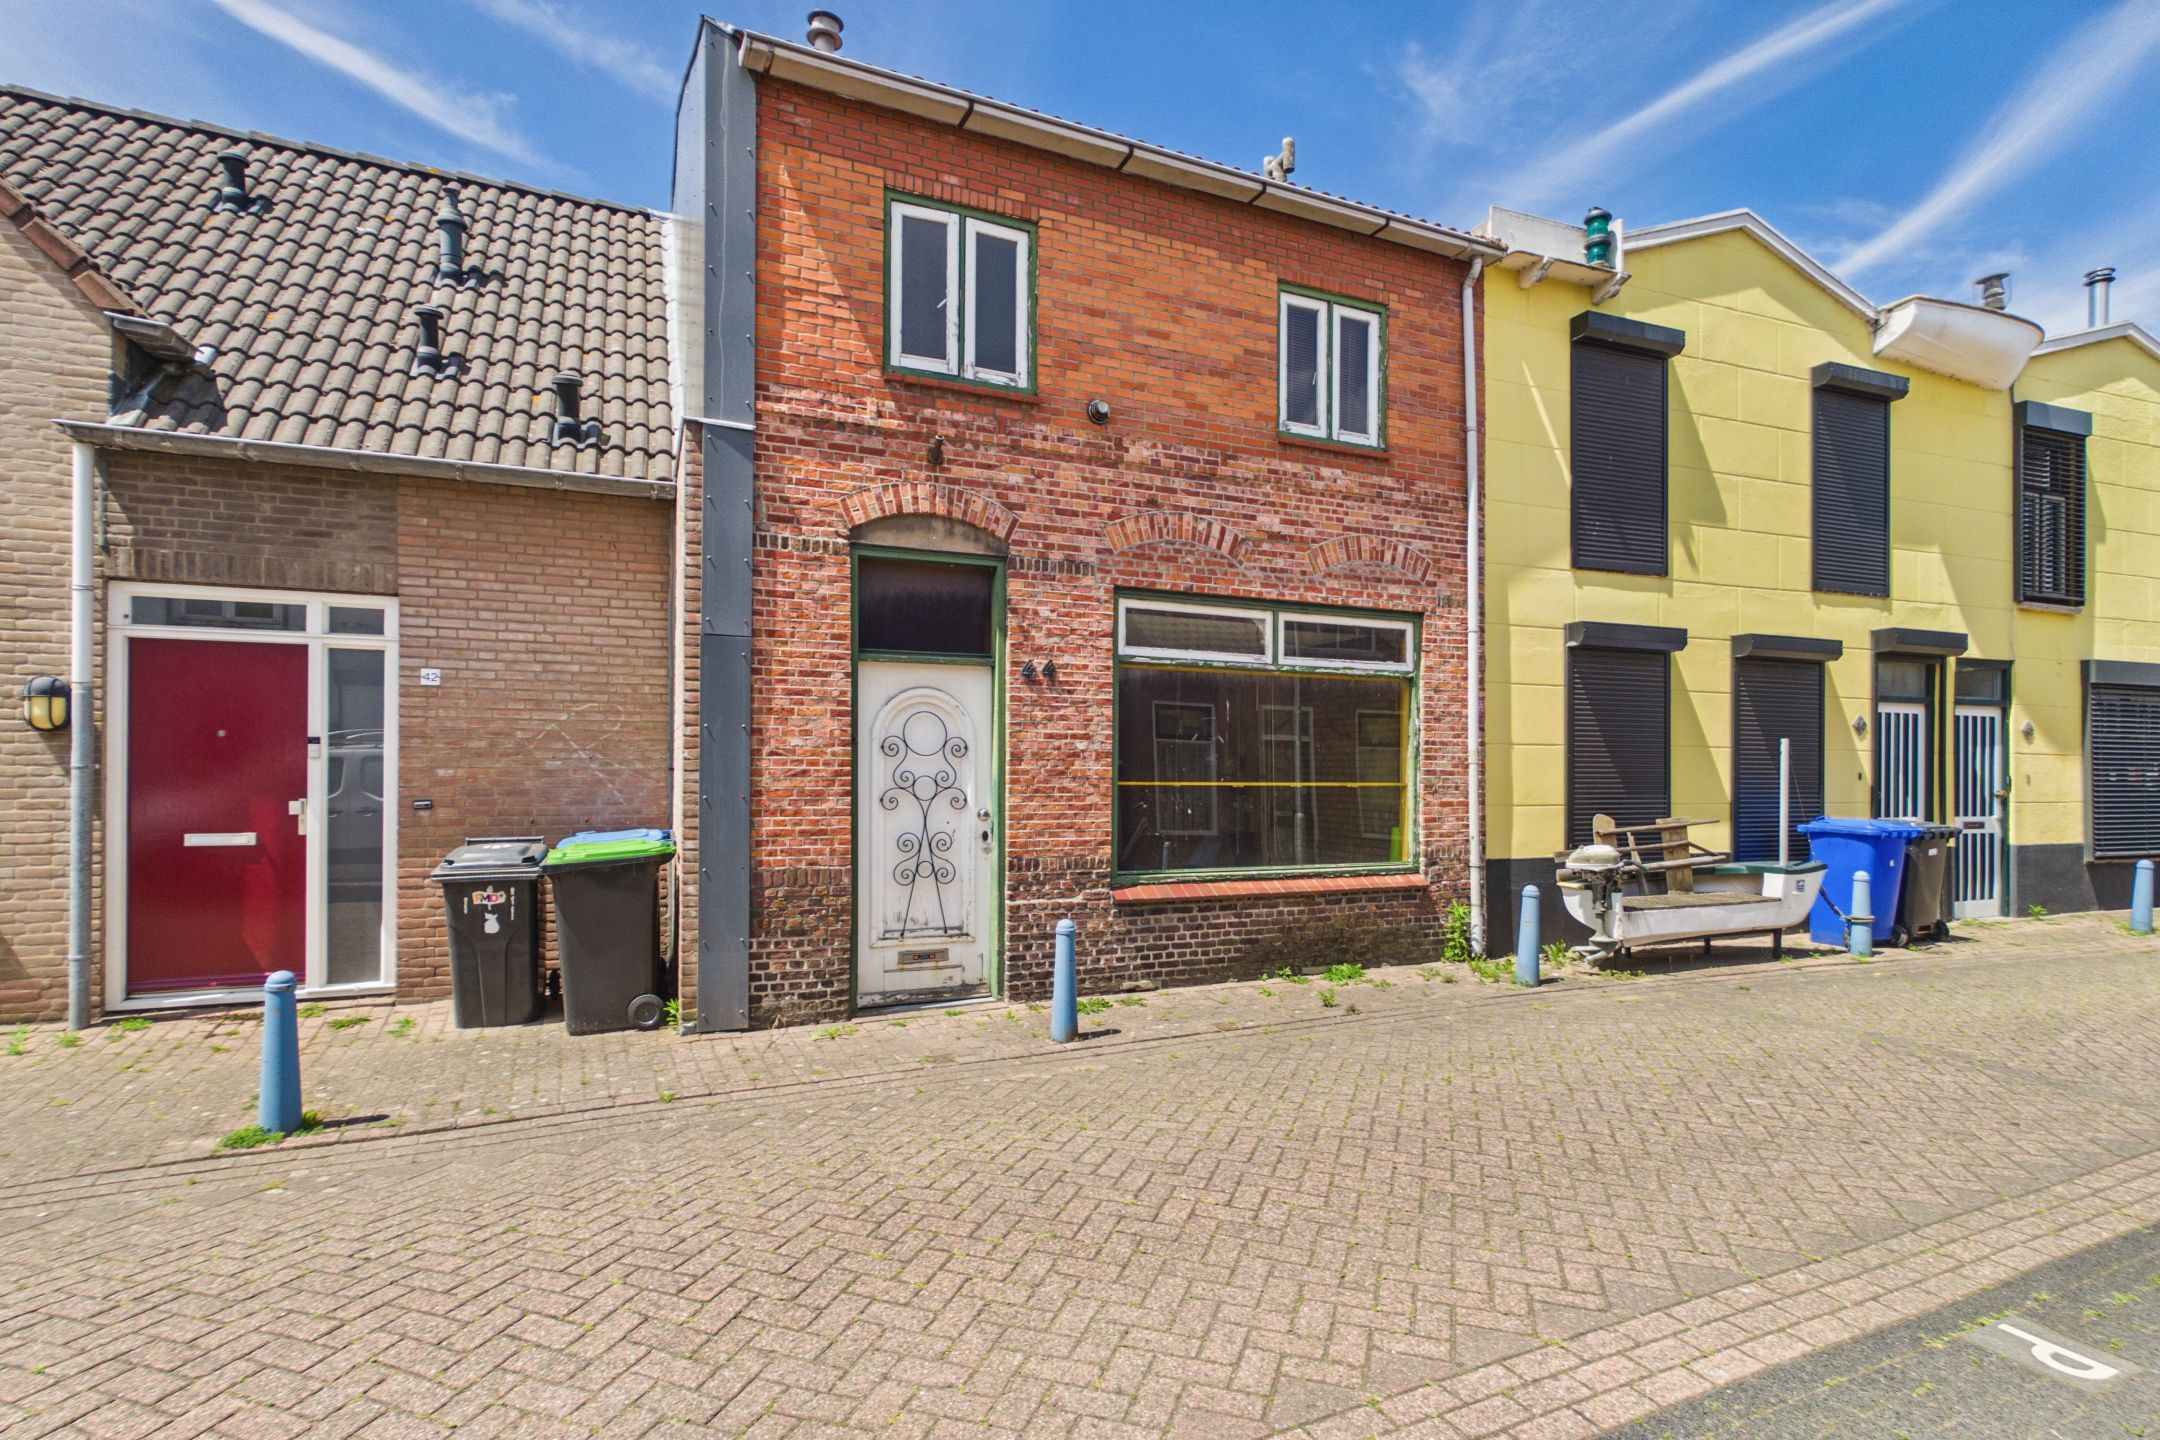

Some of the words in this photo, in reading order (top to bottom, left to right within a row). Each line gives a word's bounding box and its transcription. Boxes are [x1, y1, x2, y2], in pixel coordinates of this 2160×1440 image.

[422, 672, 440, 682] 42
[1022, 659, 1056, 679] 44
[1997, 1323, 2120, 1380] P
